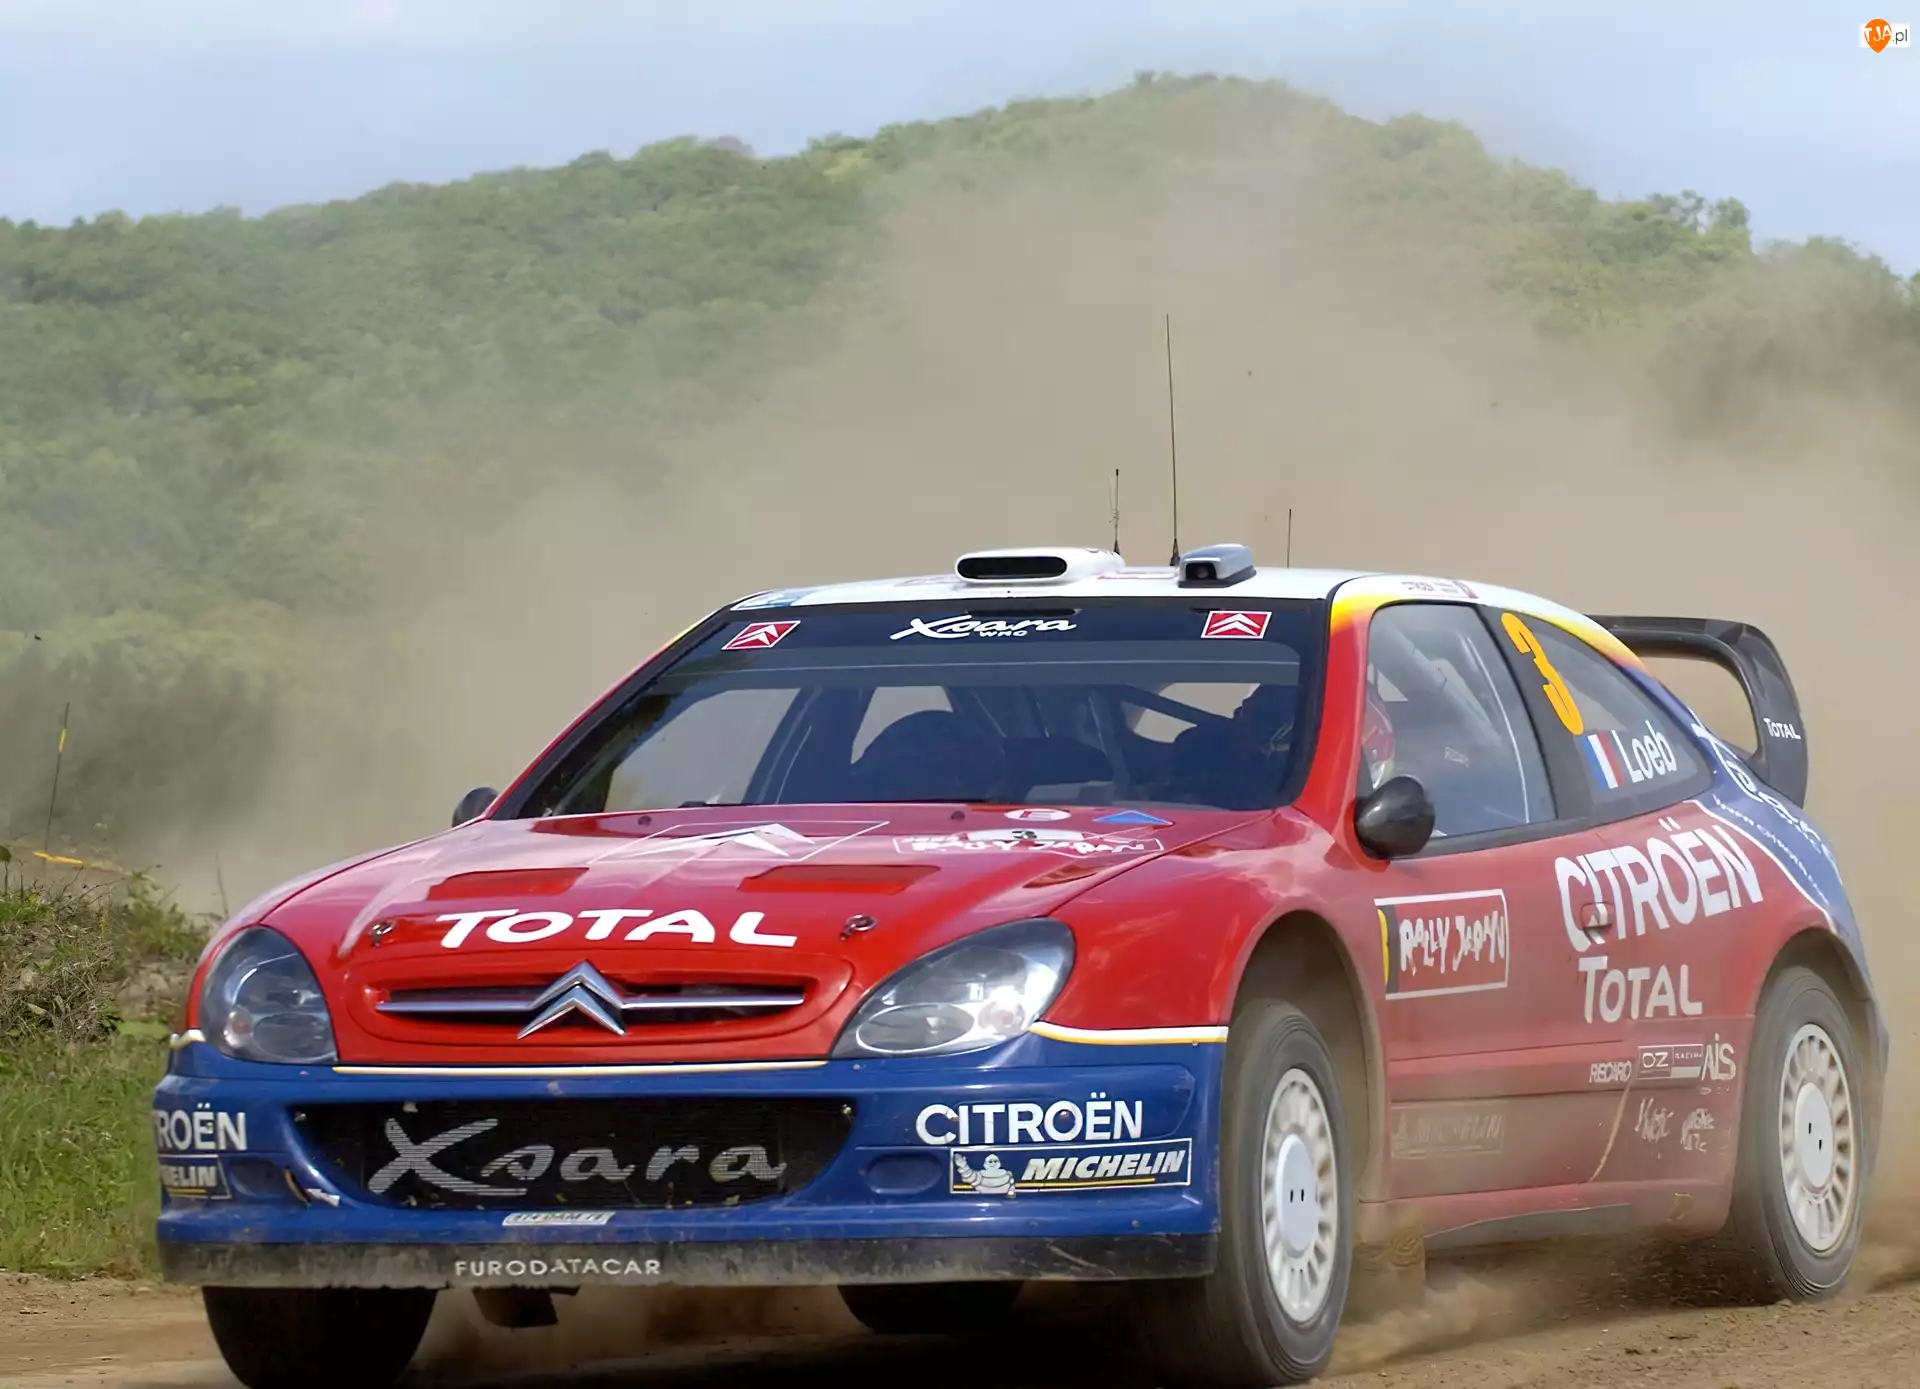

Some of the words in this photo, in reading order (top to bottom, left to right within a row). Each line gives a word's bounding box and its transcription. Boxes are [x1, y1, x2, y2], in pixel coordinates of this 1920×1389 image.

[889, 614, 1078, 640] Xsara
[1500, 612, 1584, 735] 3
[1615, 720, 1677, 784] Loeb
[1763, 717, 1801, 740] TOTAL
[1554, 816, 1764, 952] CITROËN
[436, 908, 798, 949] TOTAL
[1577, 956, 1703, 1024] TOTAL
[915, 1092, 1143, 1146] CITROËN
[367, 1118, 787, 1197] Xsara
[1020, 1150, 1187, 1182] MICHELIN
